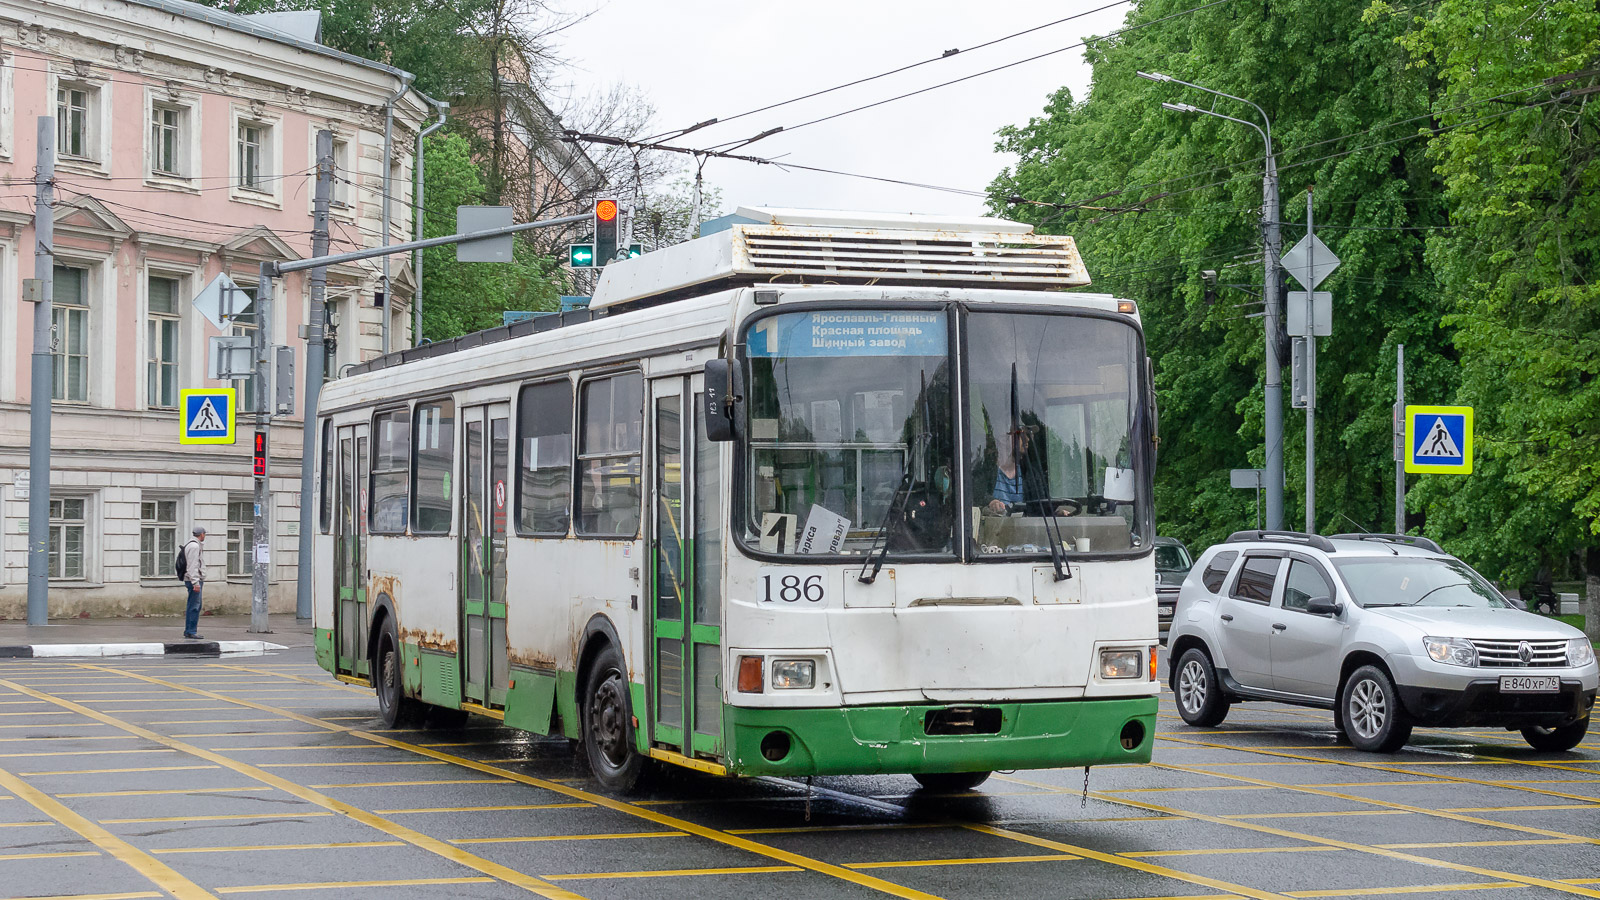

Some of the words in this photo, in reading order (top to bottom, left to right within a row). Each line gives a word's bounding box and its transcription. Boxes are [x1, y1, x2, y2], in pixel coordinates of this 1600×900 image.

[812, 313, 937, 323] Ярославль-Главный
[756, 317, 778, 353] 1
[812, 326, 864, 336] Красная
[867, 327, 923, 336] площадь
[812, 337, 866, 349] Шинный
[869, 339, 906, 348] завод
[767, 516, 788, 554] 1
[762, 574, 825, 603] 186
